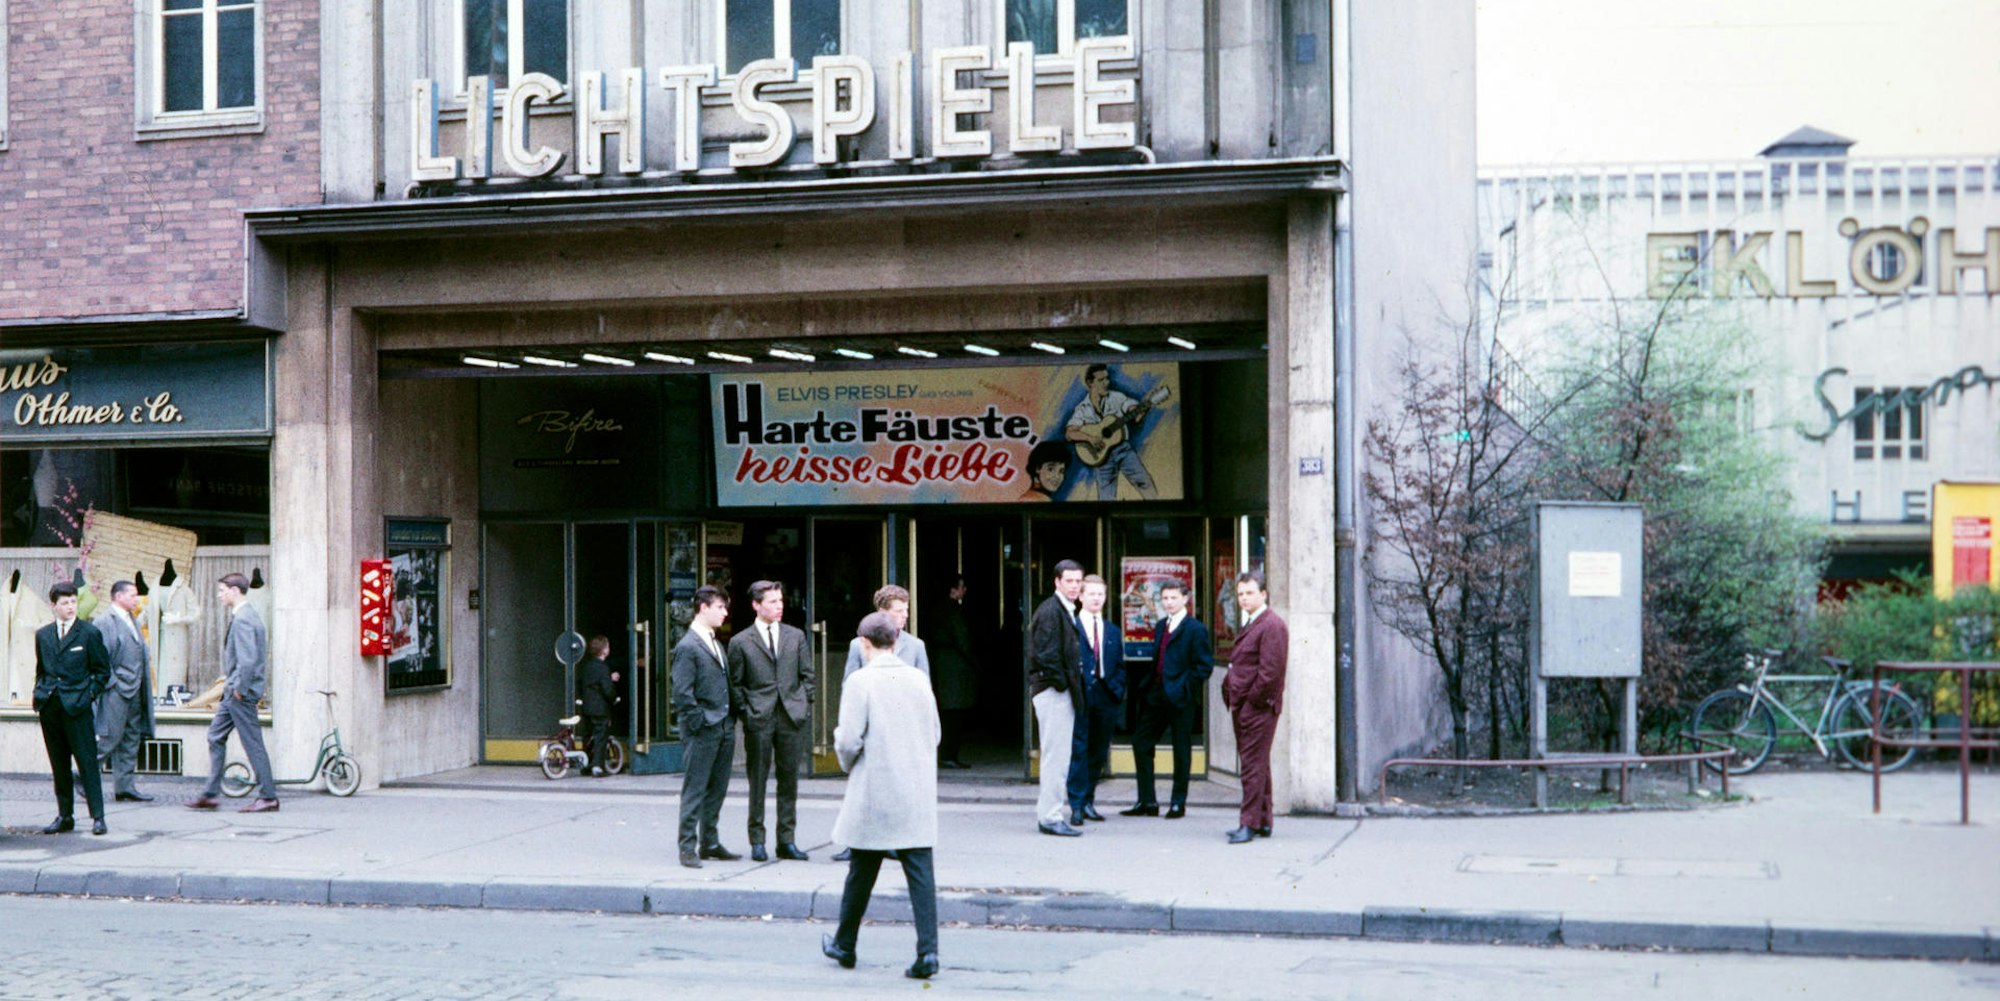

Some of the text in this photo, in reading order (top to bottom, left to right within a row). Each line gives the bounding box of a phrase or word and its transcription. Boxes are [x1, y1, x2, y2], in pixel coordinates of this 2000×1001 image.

[411, 35, 1137, 182] LICHTSPIELE
[1646, 216, 2000, 298] EKLÖH
[14, 391, 124, 426] Othmer
[723, 383, 1038, 446] Harte Fäuste,
[777, 386, 830, 403] ELVIS
[834, 383, 919, 401] PRESLEY
[734, 443, 1016, 486] heisse Liebe
